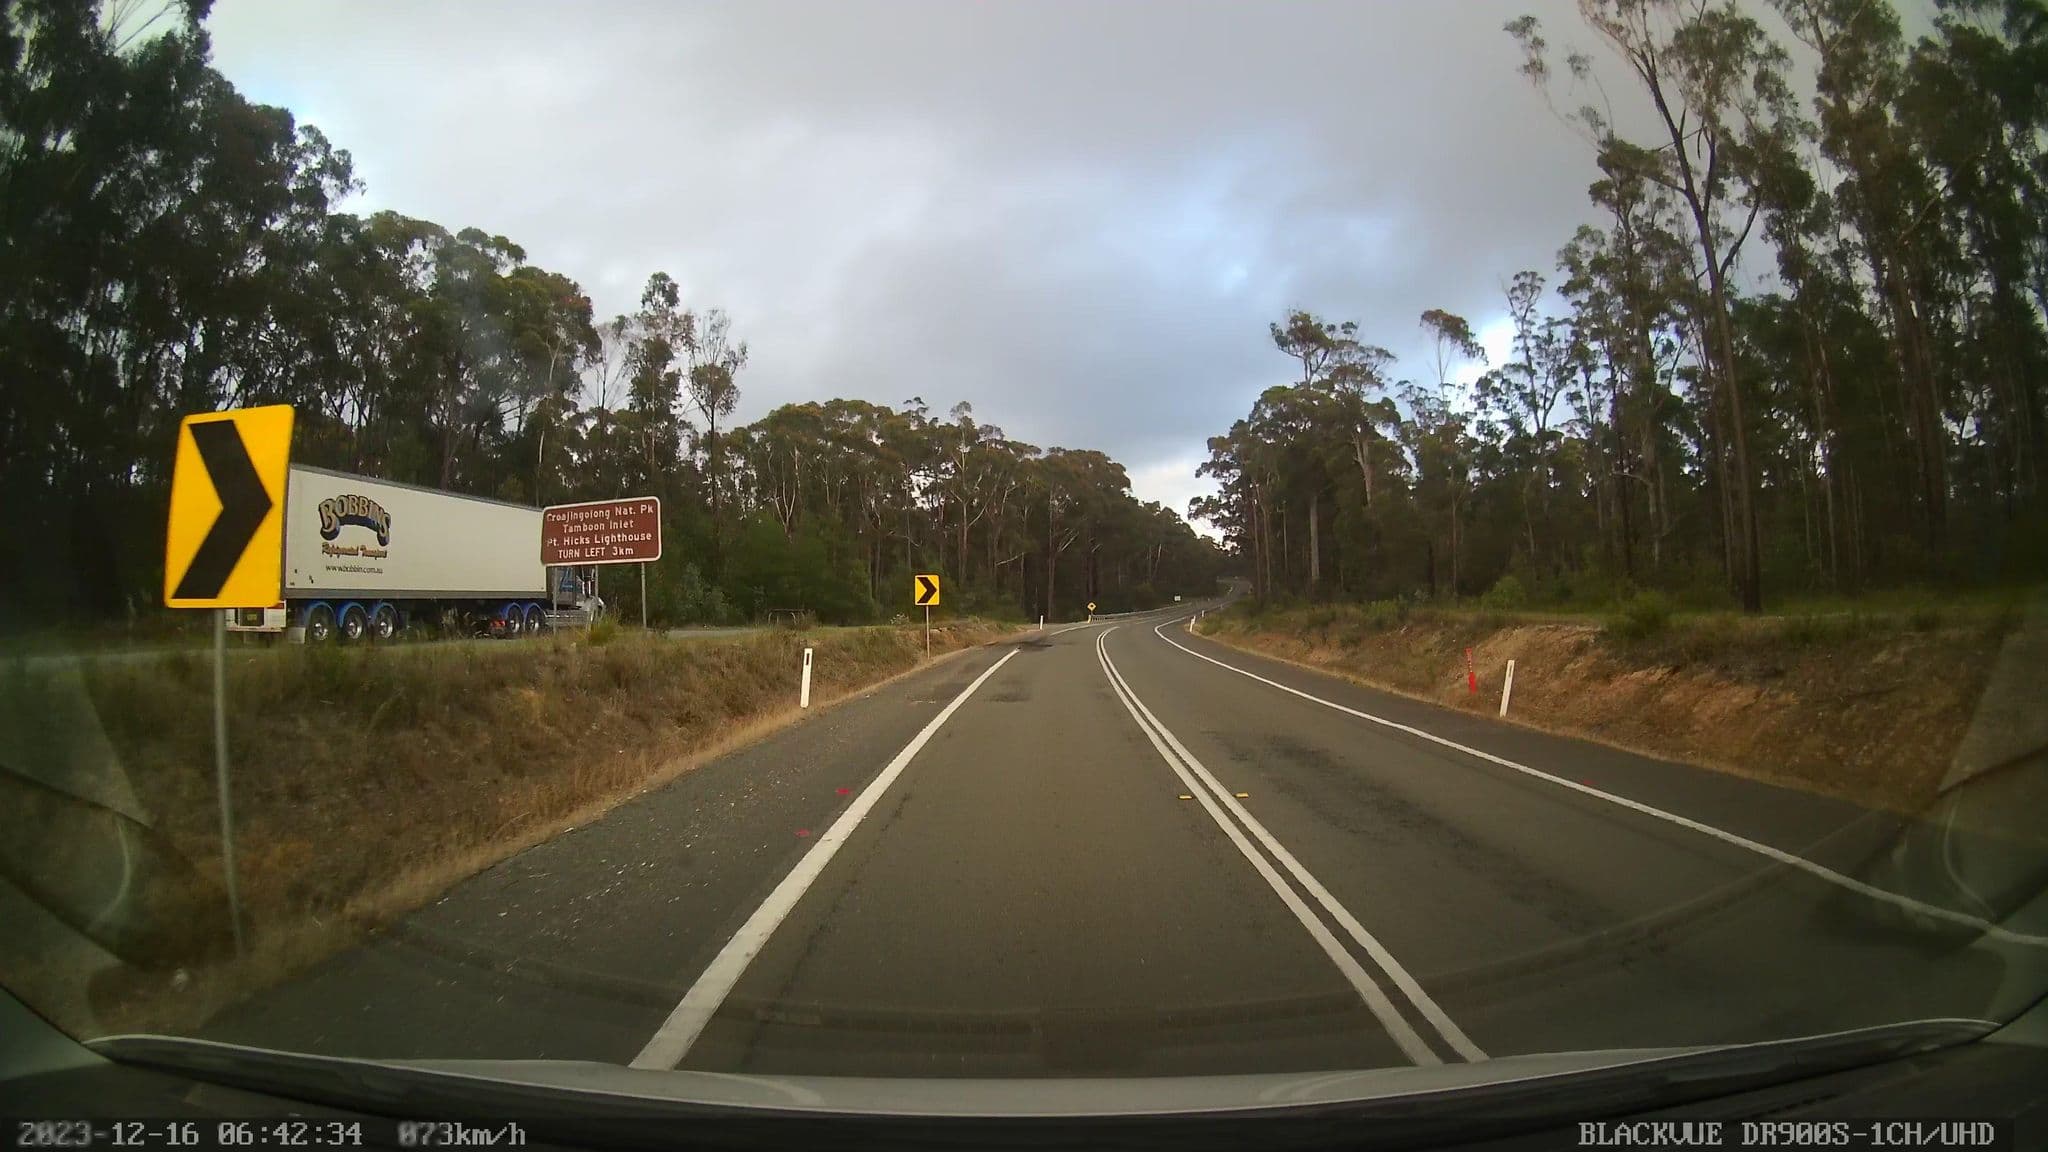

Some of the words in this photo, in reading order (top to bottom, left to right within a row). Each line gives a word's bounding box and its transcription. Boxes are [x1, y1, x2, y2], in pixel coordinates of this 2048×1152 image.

[318, 494, 391, 542] BOBBINS
[546, 510, 610, 522] Croajingolong
[615, 506, 636, 516] Nat.
[640, 504, 653, 513] Pk
[563, 523, 605, 533] Tamboon
[609, 519, 634, 529] Inlet
[547, 538, 560, 547] Pt.
[563, 535, 590, 545] Hicks
[594, 532, 652, 545] Lighthouse
[558, 549, 580, 559] TURN
[585, 547, 606, 557] LEFT
[612, 546, 634, 556] 3km
